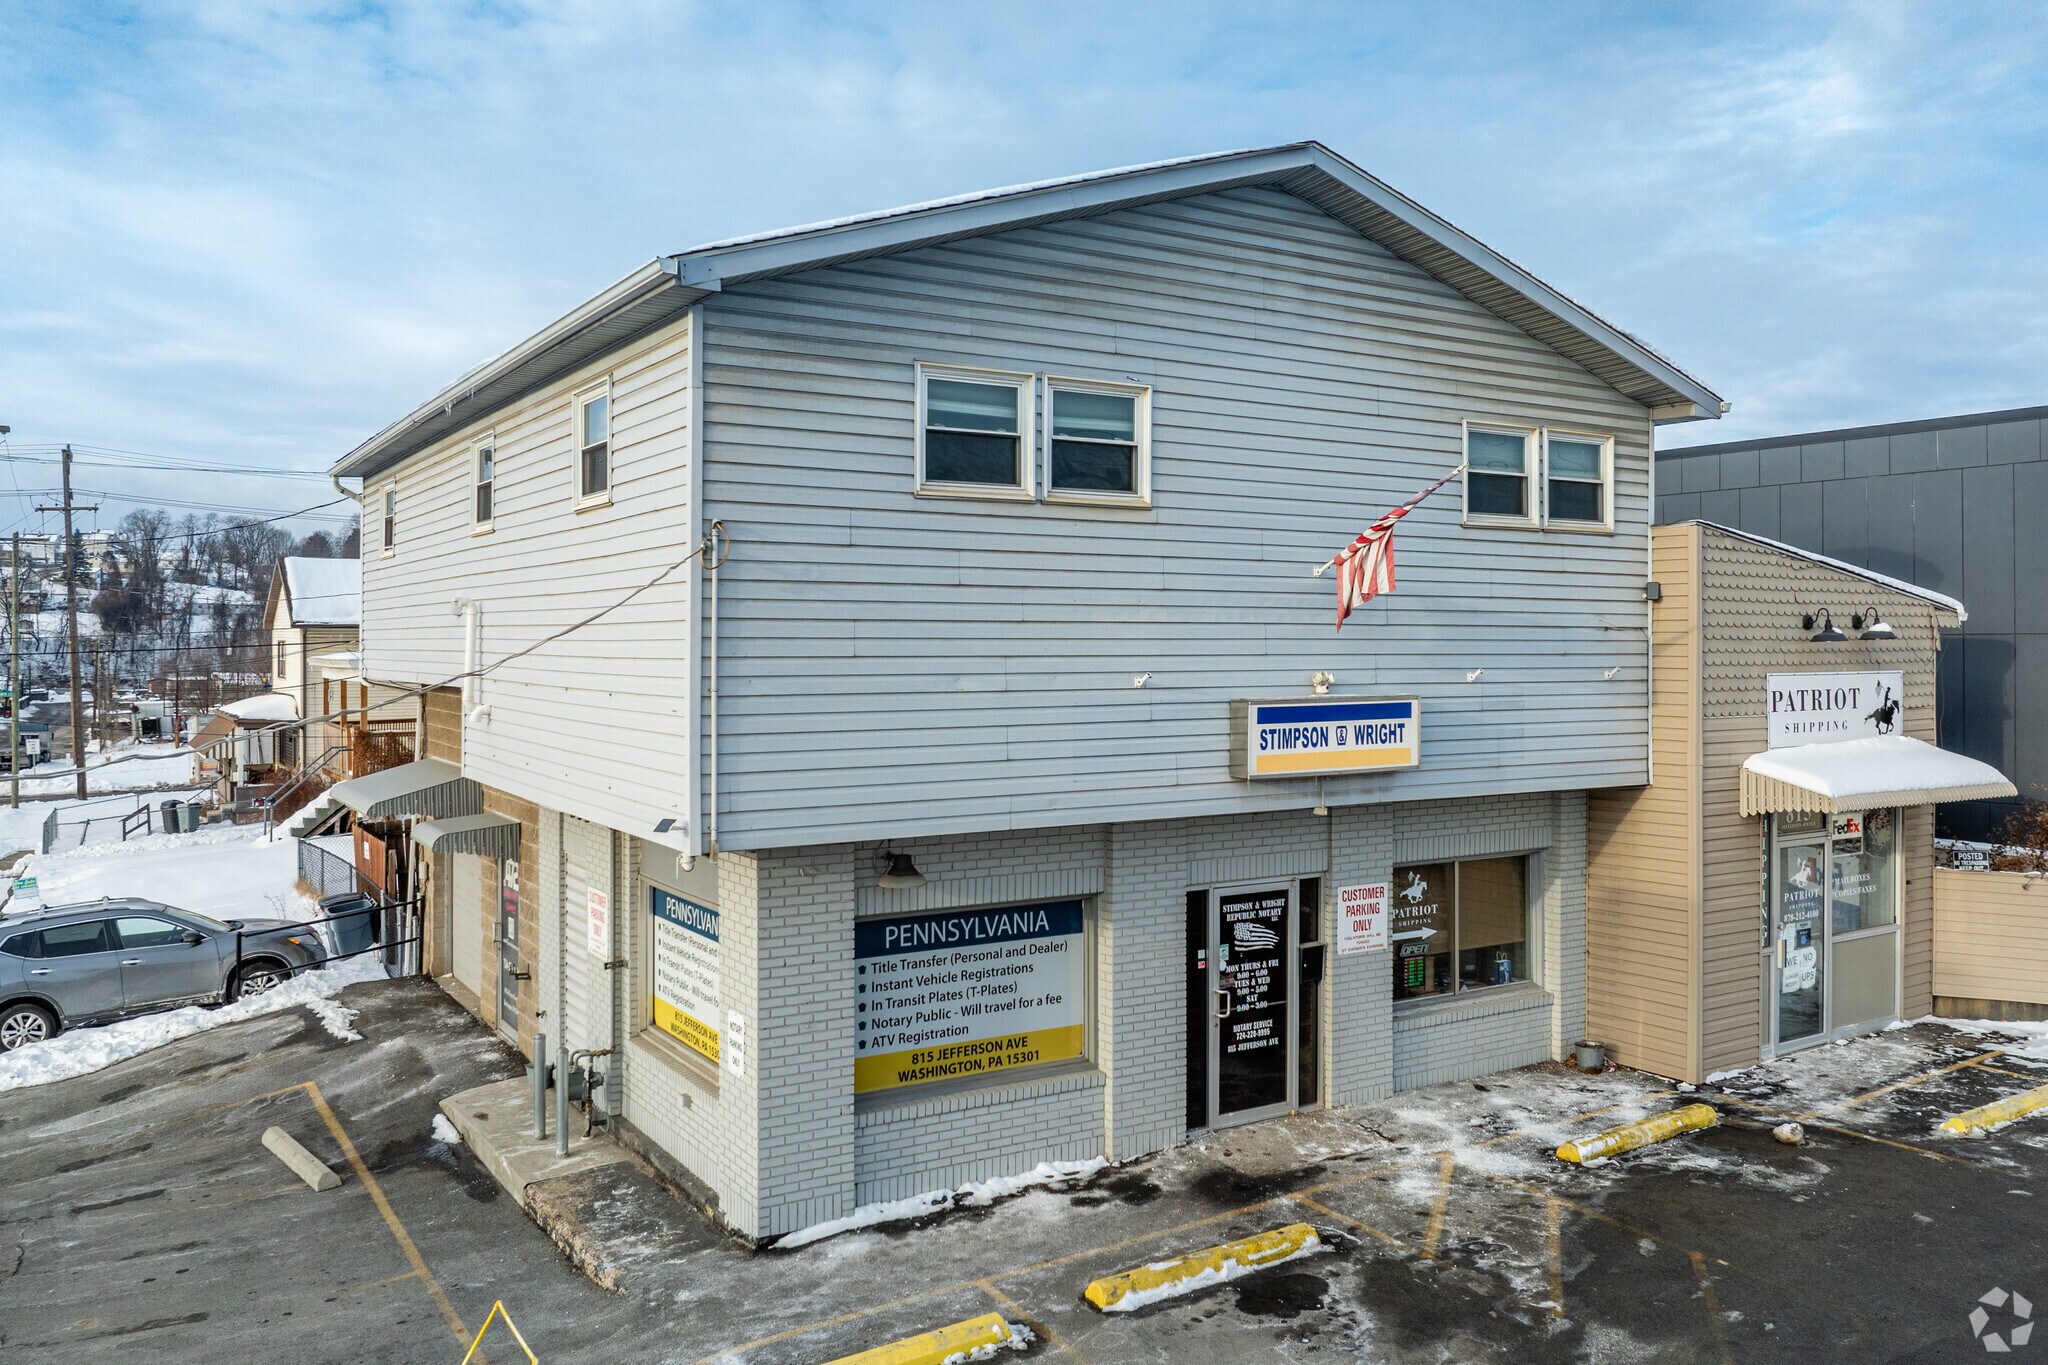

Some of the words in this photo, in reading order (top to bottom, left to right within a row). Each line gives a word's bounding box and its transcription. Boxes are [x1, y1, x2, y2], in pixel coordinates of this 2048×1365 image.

[1771, 688, 1860, 712] PATRIOT
[1785, 720, 1848, 734] SHIPPING
[1260, 726, 1328, 750] STIMPSON
[1354, 723, 1406, 745] WRIGHT
[1832, 818, 1860, 834] FedEx
[1958, 852, 1983, 860] POSTED
[1834, 873, 1870, 885] MAILBOXES
[1342, 886, 1384, 902] CUSTOMER
[1784, 888, 1819, 902] PATRIOT
[1223, 902, 1253, 912] STIMPSON
[1255, 901, 1260, 909] &
[1262, 898, 1285, 908] WRIGHT
[1346, 902, 1380, 918] PARKING
[1392, 904, 1438, 919] PATRIOT
[1790, 902, 1814, 910] SHIPPING
[1226, 911, 1256, 922] REPUBLIC
[1258, 908, 1282, 918] NOTARY
[1398, 918, 1432, 926] SHIPPING
[886, 910, 1049, 948] PENNSYLVANIA
[1353, 918, 1372, 932] ONLY
[672, 928, 687, 942] Transfer
[871, 961, 897, 974] Title
[900, 955, 947, 970] Transfer
[950, 947, 1002, 966] (Personal
[1006, 945, 1026, 958] and
[1030, 940, 1068, 955] Dealer)
[1803, 952, 1813, 962] NO
[1241, 961, 1260, 970] THURS
[1262, 960, 1267, 968] &
[1269, 959, 1278, 967] FRI
[872, 978, 913, 992] Instant
[916, 971, 958, 986] Vehicle
[961, 964, 1034, 982] Registrations
[1234, 979, 1250, 988] TUES
[1251, 978, 1256, 986] &
[1257, 976, 1270, 984] WED
[1802, 971, 1814, 982] UPS
[872, 1000, 882, 1011] In
[886, 994, 926, 1009] Transit
[929, 988, 963, 1003] Plates
[966, 981, 1018, 999] (T-Plates)
[1246, 994, 1258, 1002] SAT
[872, 1016, 912, 1030] Notary
[916, 1008, 951, 1023] Public
[960, 1003, 982, 1016] Will
[984, 998, 1016, 1014] travel
[1019, 997, 1034, 1008] for
[1046, 994, 1062, 1004] fee
[674, 1011, 683, 1024] 815
[684, 1016, 708, 1038] JEFFERSON
[709, 1031, 718, 1044] AVE
[1233, 1022, 1252, 1032] NOTARY
[1253, 1019, 1273, 1030] SERVICE
[872, 1034, 896, 1048] ATV
[899, 1026, 968, 1044] Registration
[1238, 1040, 1267, 1051] JEFFERSON
[1268, 1037, 1279, 1046] AVE
[912, 1051, 934, 1064] 815
[936, 1040, 1002, 1061] JEFFERSON
[1006, 1036, 1028, 1050] AVE
[898, 1058, 985, 1082] WASHINGTON,
[988, 1056, 1002, 1068] PA
[1006, 1050, 1039, 1064] 15301
